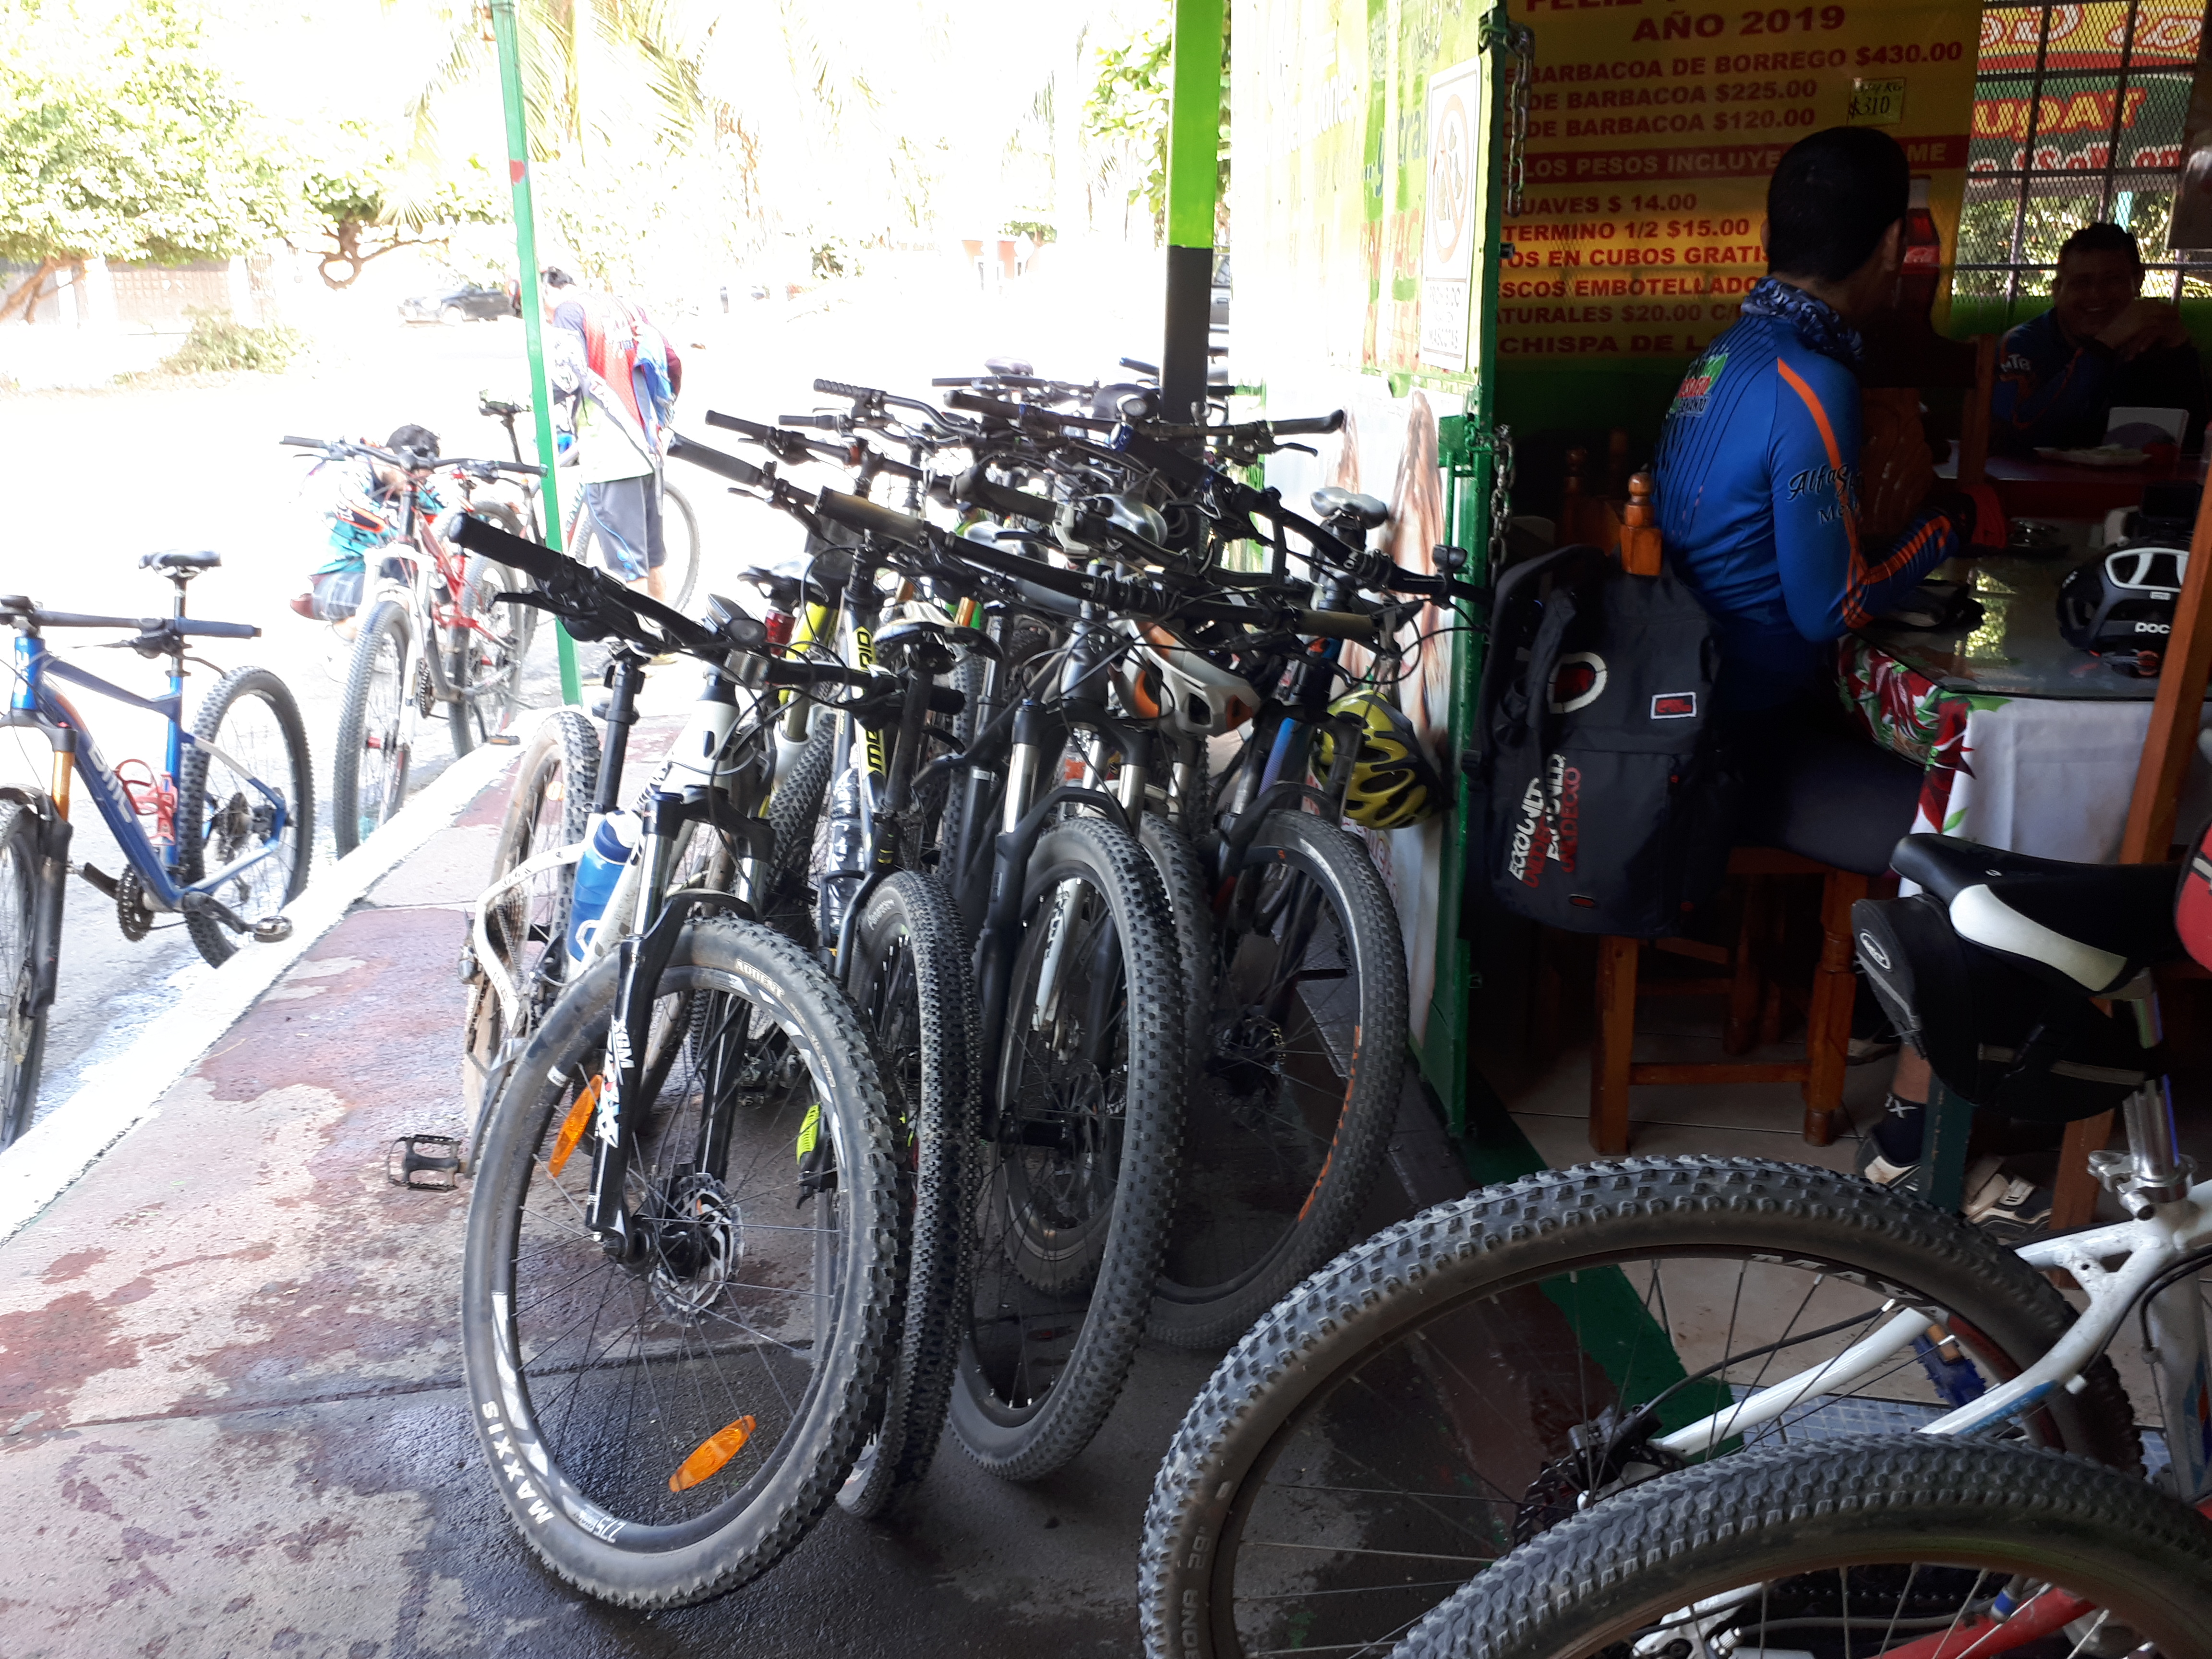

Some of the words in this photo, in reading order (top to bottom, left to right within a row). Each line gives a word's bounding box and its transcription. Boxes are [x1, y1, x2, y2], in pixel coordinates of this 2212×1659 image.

[1632, 10, 1724, 42] AÑO
[1739, 6, 1845, 36] 2019
[1531, 60, 1663, 84] BARBACOA
[1672, 57, 1706, 75] DE
[1714, 49, 1846, 73] BORREGO
[1855, 41, 1963, 66] $430.00
[1530, 93, 1558, 110] DE
[1567, 86, 1707, 109] BARBACOA
[1716, 79, 1818, 103] $225.00
[1849, 96, 1890, 118] $310
[1528, 121, 1557, 138] DE
[1565, 113, 1705, 137] BARBACOA
[1713, 108, 1815, 131] $120.00
[1524, 158, 1569, 177] LOS
[1575, 155, 1659, 176] PESOS
[1667, 149, 1779, 172] INCLUYE
[1608, 196, 1621, 213] $
[1631, 193, 1697, 211] 14.00
[1503, 222, 1615, 241] TERMINO
[1624, 221, 1658, 239] 1/2
[1667, 218, 1749, 239] $15.00
[1548, 250, 1580, 267] EN
[1589, 247, 1675, 266] CUBOS
[1621, 303, 1702, 323] $20.00
[1499, 336, 1619, 354] CHISPA
[1631, 335, 1675, 353] DE
[481, 1400, 555, 1525] MAXXIS
